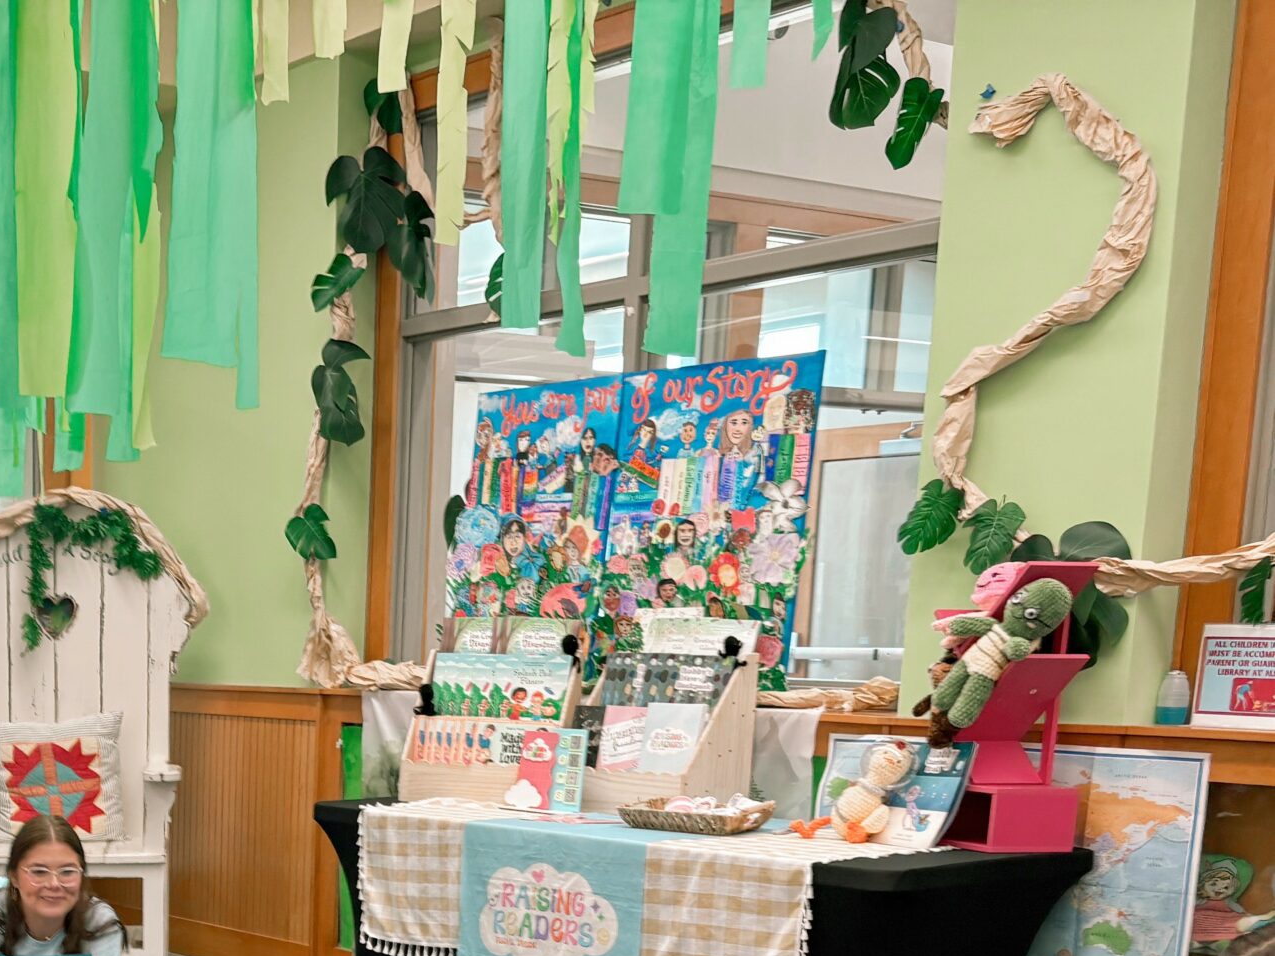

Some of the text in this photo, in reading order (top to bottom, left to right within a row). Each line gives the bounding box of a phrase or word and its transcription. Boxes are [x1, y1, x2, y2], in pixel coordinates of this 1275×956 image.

[501, 360, 798, 437] You are part of our Story
[1214, 640, 1228, 649] ALL
[1229, 641, 1269, 649] CHILDREN
[1232, 650, 1242, 658] BE
[1217, 668, 1251, 676] LIBRARY
